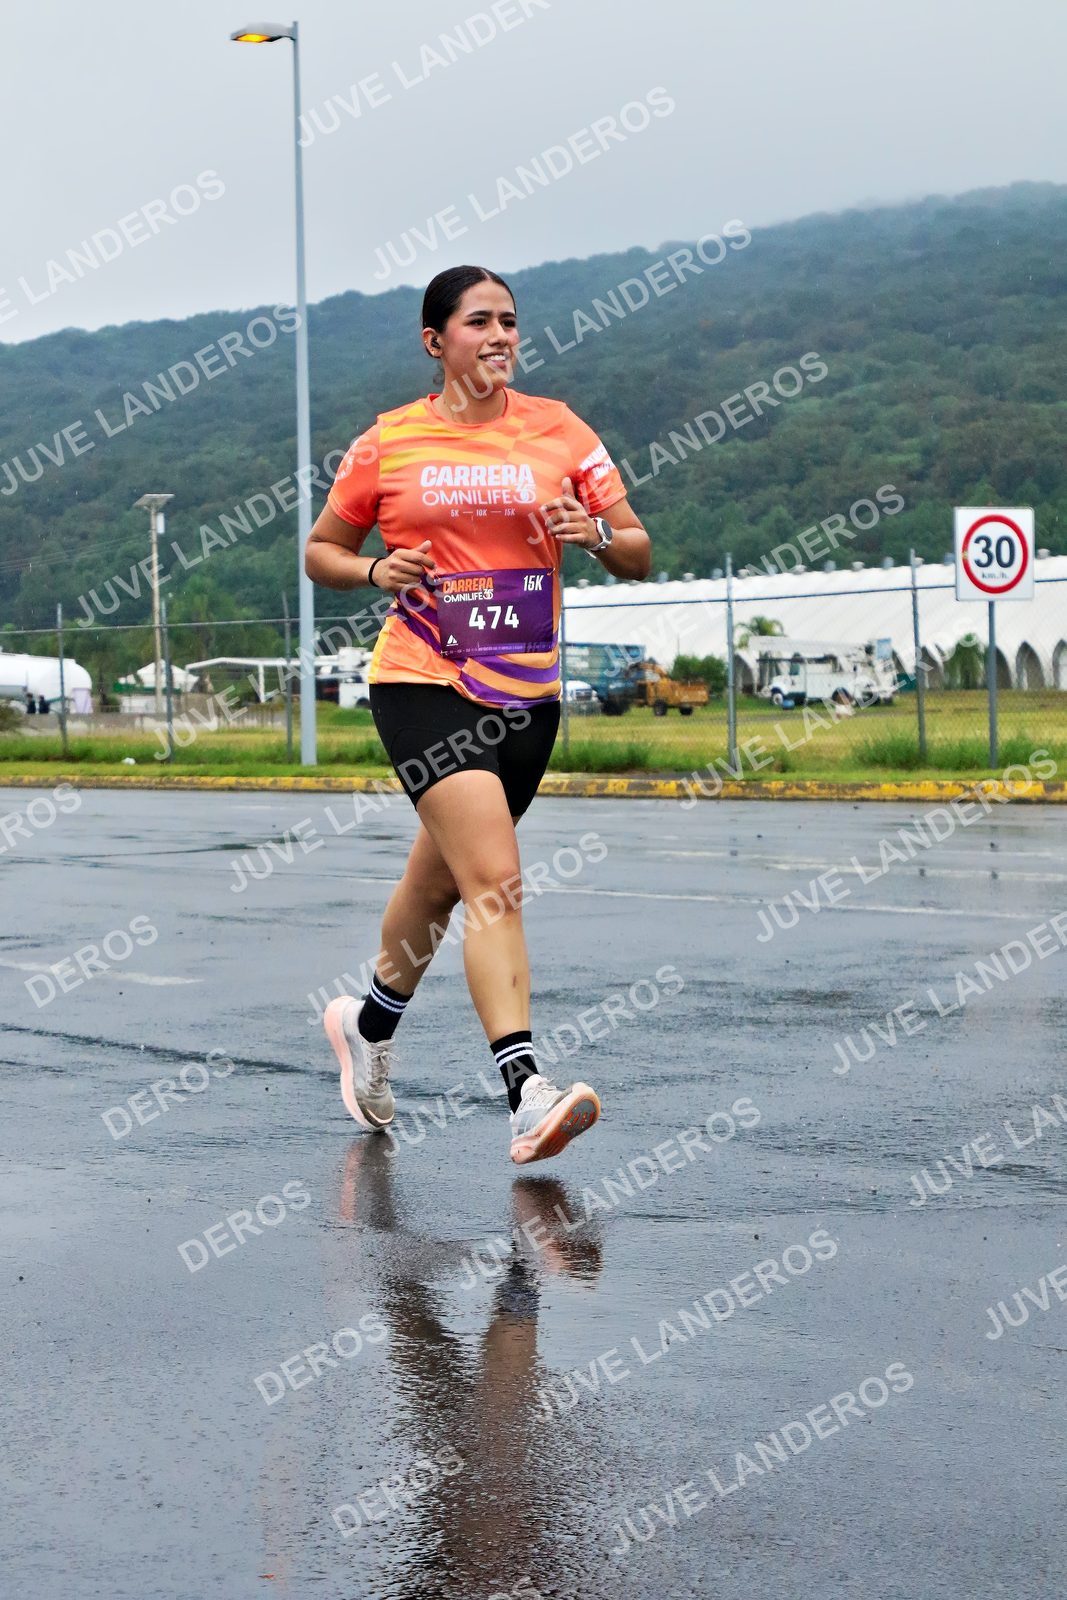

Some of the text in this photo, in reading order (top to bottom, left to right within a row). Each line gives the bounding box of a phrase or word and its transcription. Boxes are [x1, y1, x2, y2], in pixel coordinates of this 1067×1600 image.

[420, 464, 535, 487] CARRERA
[422, 489, 513, 506] OMNILIFE
[476, 508, 488, 516] 10K
[504, 508, 515, 516] 15K
[973, 535, 1016, 568] 30
[443, 577, 494, 594] CARRERA
[523, 575, 543, 591] 15K
[443, 592, 482, 603] OMNILIFE
[468, 605, 519, 629] 474
